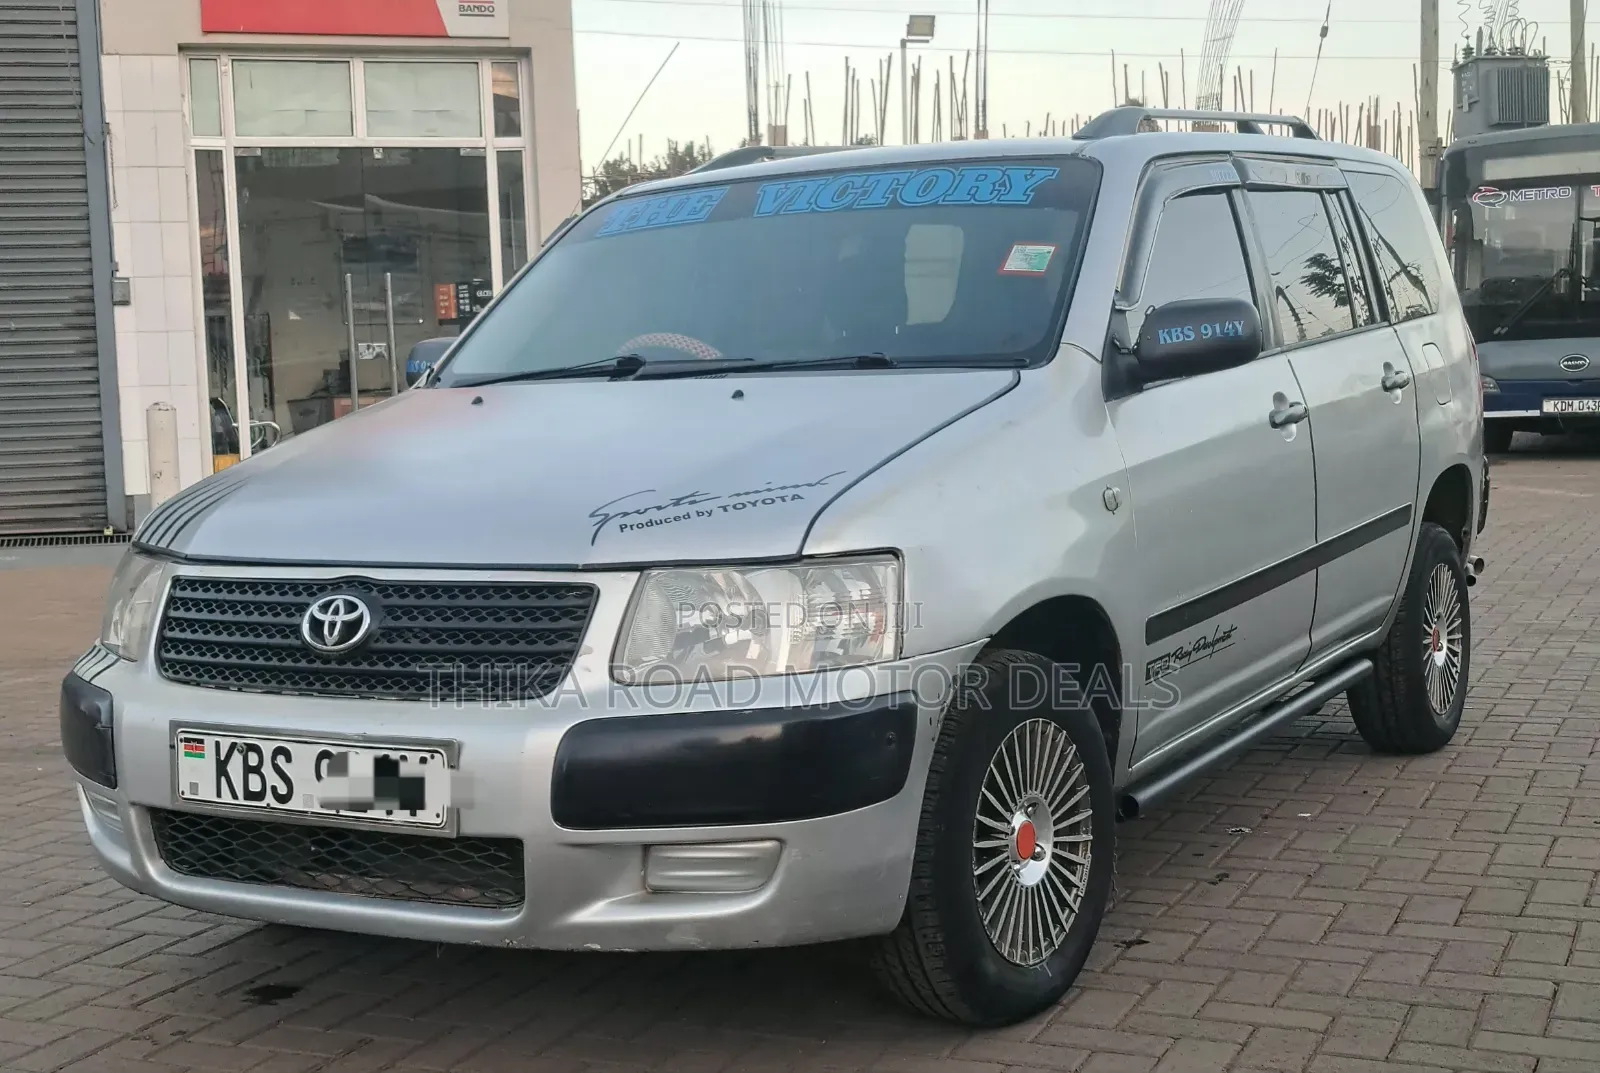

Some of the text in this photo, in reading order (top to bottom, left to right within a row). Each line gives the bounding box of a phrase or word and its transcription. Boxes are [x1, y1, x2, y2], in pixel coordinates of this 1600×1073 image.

[458, 4, 495, 13] BANDO
[596, 167, 1059, 236] THE VICTORY
[1509, 186, 1572, 202] METRO
[1158, 320, 1245, 345] KBS 914Y
[1553, 400, 1574, 412] KDM
[618, 493, 805, 533] Produced by TOYOTA
[214, 739, 295, 805] KBS
